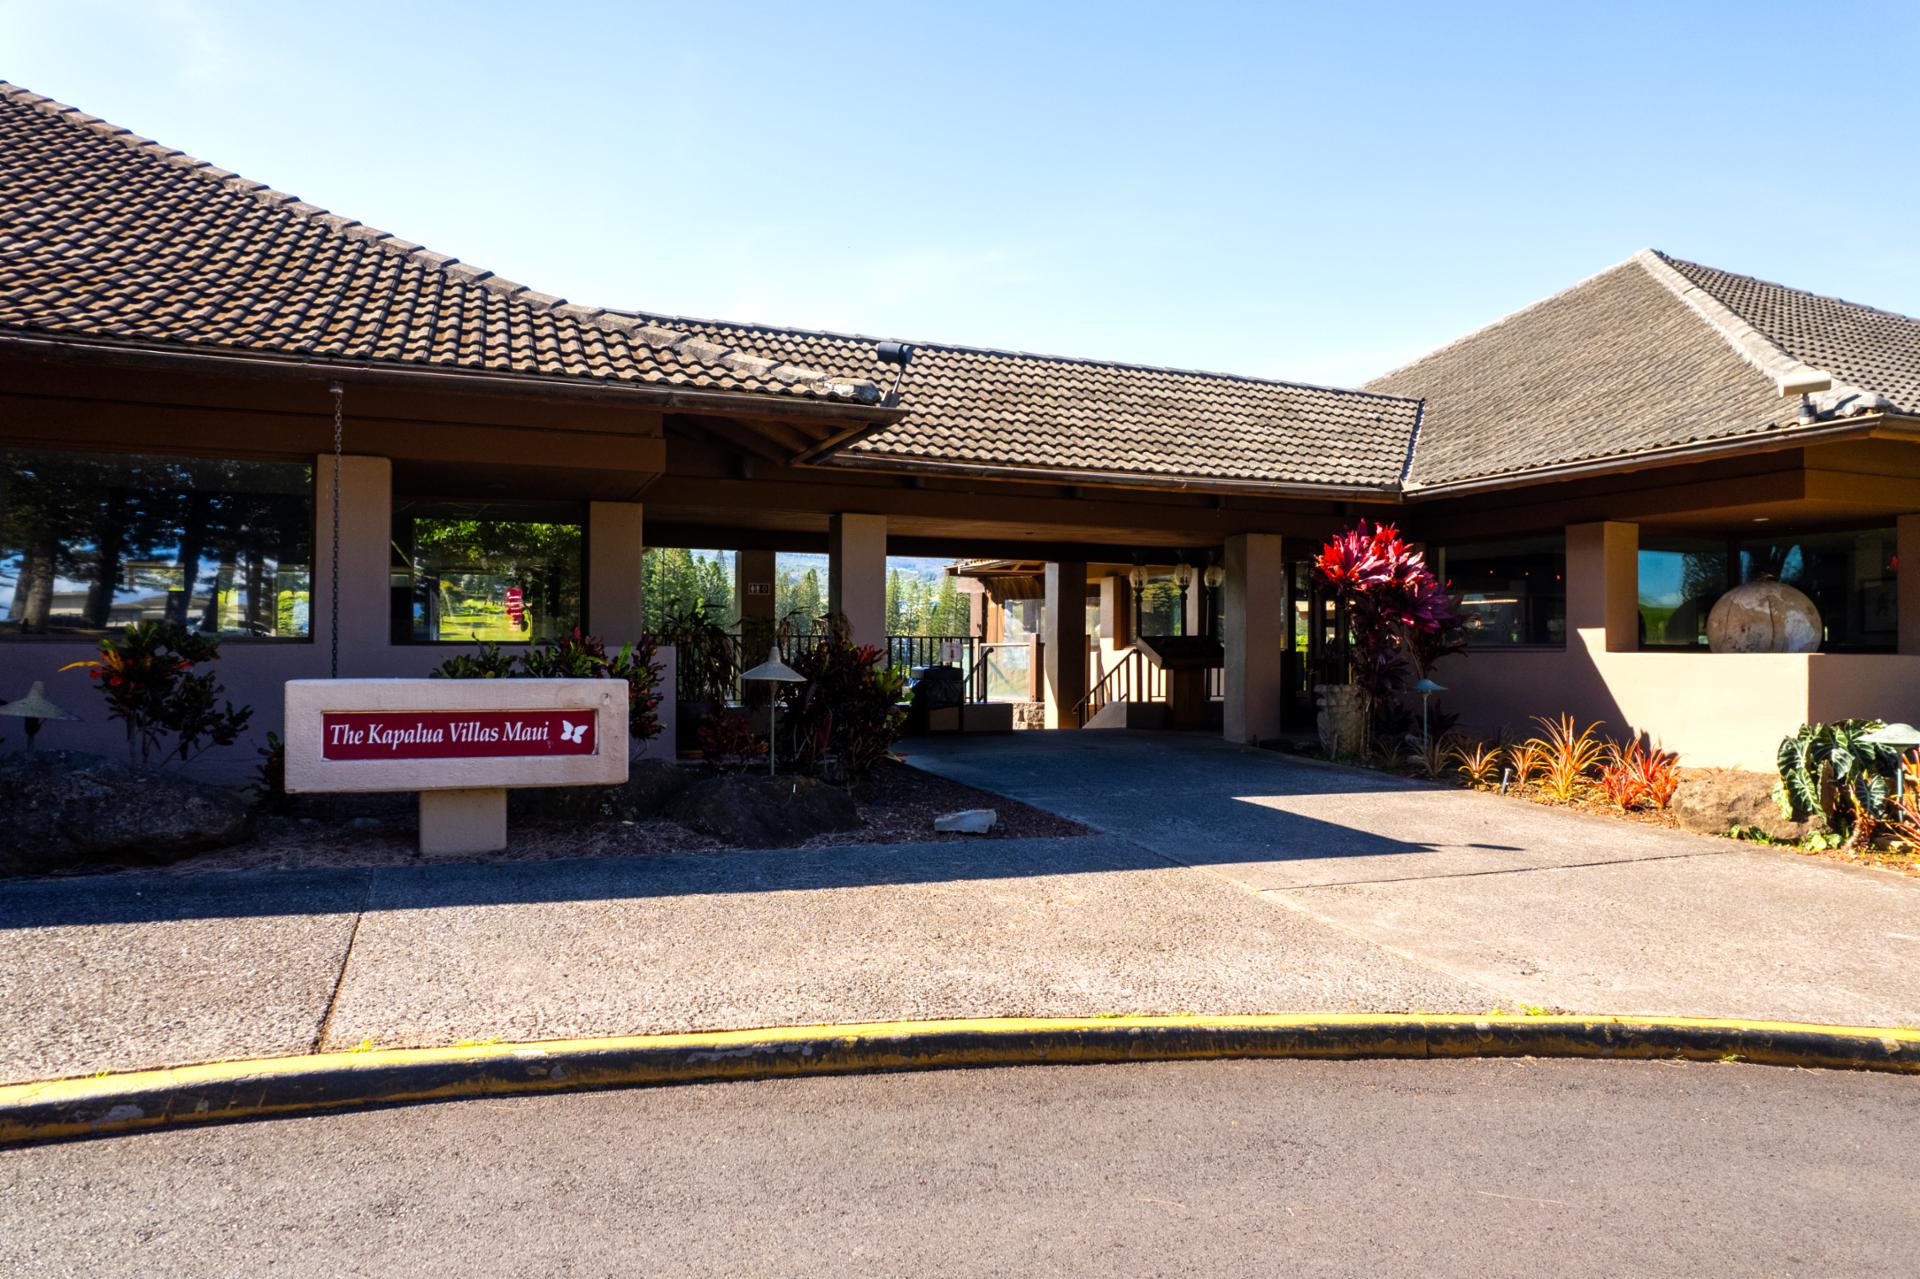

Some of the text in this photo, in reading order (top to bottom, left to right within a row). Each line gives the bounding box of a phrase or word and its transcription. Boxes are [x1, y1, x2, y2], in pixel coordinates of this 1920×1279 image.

[330, 721, 549, 750] The Kapalua Villas Maui
